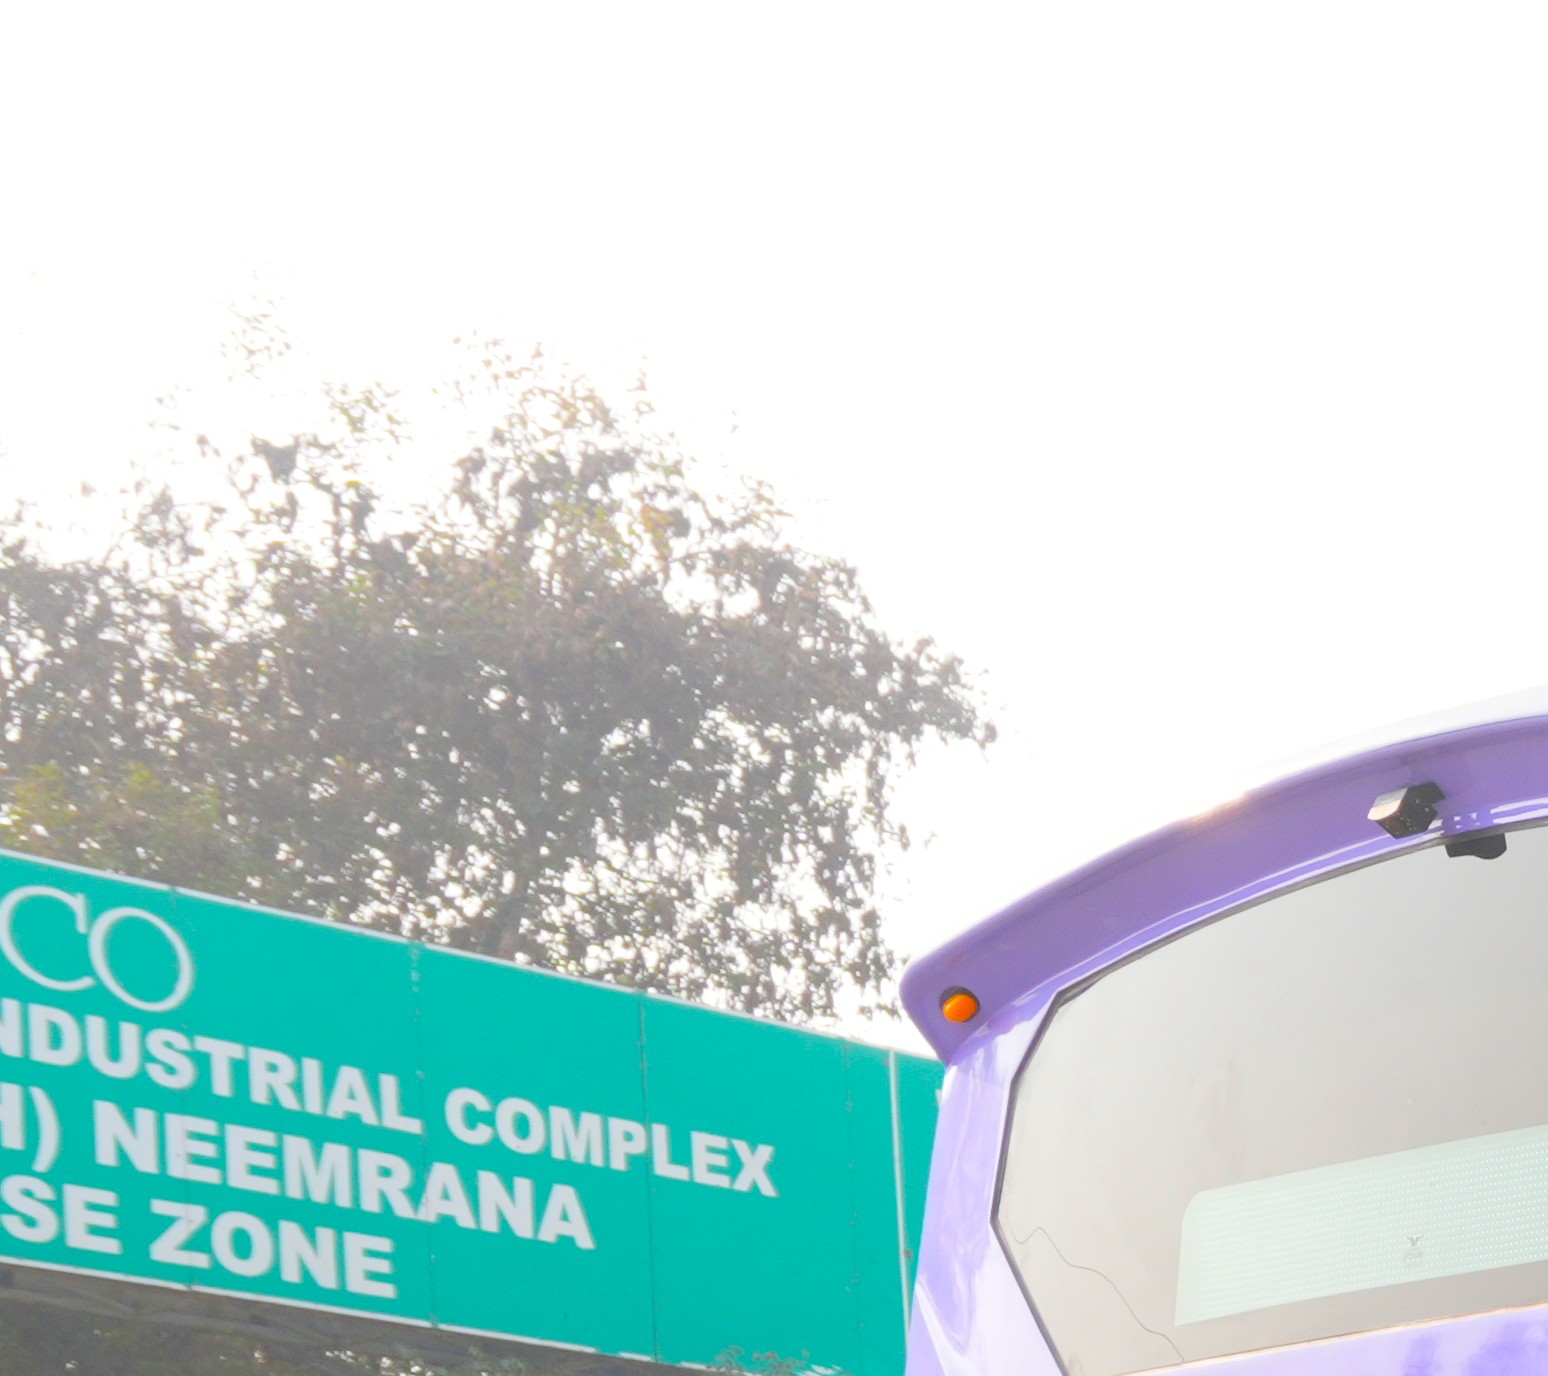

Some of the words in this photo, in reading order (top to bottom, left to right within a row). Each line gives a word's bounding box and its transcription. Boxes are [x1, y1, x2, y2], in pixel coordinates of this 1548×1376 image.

[93, 1100, 594, 1250] NEEMRANA
[444, 1087, 777, 1198] COMPLEX
[149, 1198, 397, 1299] ZONE
